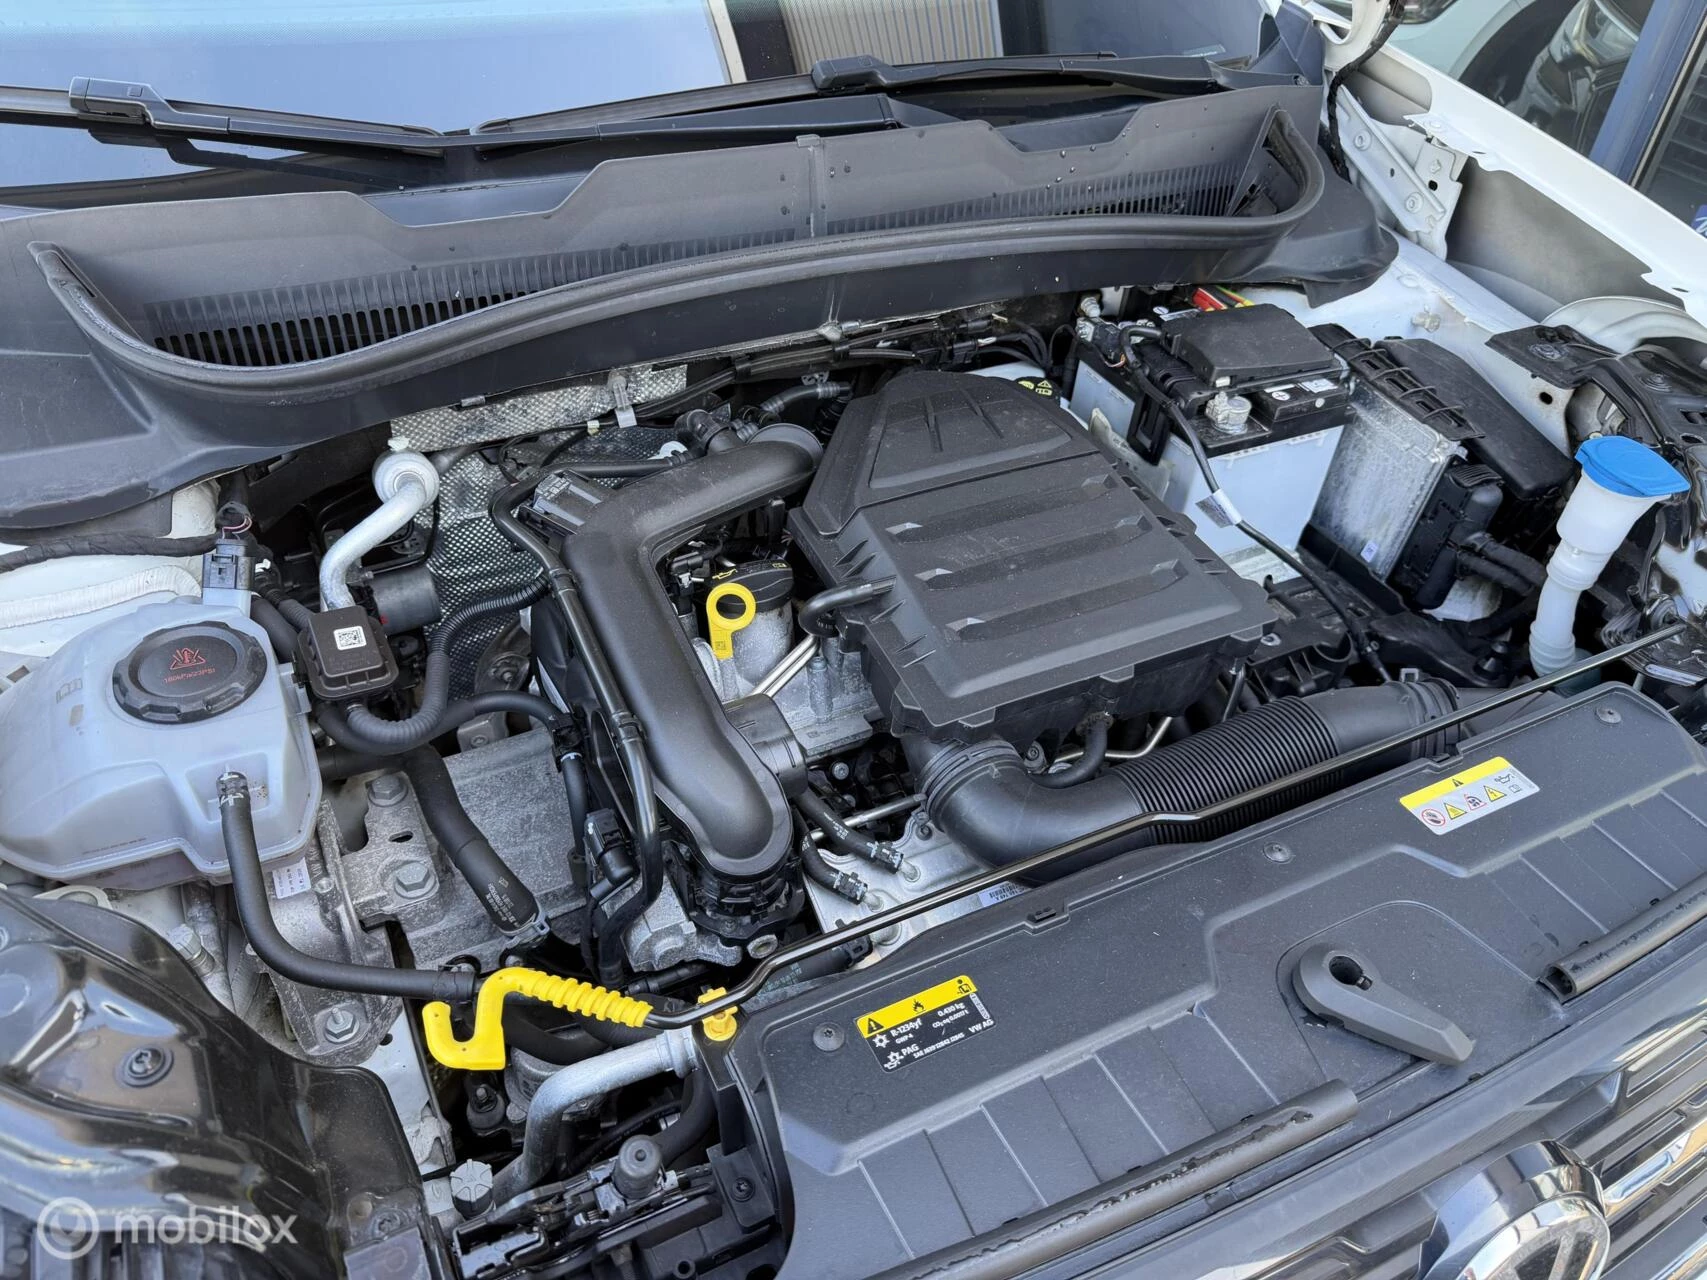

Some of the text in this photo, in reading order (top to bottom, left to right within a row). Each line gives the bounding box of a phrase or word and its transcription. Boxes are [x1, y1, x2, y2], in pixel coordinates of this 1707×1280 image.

[955, 1002, 966, 1010] kg
[890, 1018, 922, 1037] R-1234yf
[968, 1018, 994, 1033] VW AG
[901, 1043, 919, 1056] PAG
